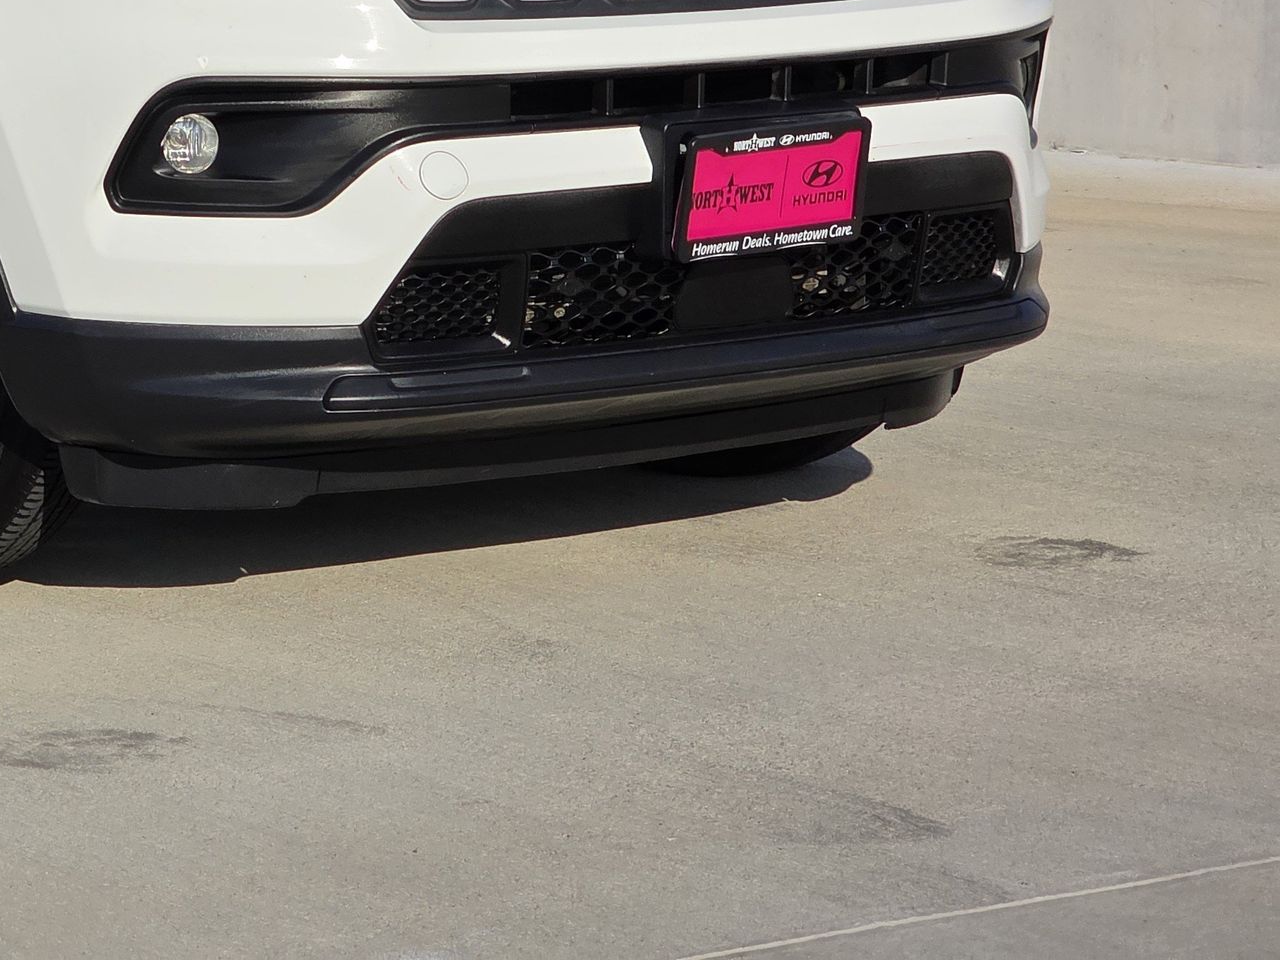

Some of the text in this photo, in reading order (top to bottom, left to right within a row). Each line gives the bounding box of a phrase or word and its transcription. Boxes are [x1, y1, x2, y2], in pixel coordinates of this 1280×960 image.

[795, 132, 830, 143] HYUNDAI
[793, 190, 847, 207] HYUNDAI
[692, 224, 853, 257] Homerun Deals. Hometown Care.
